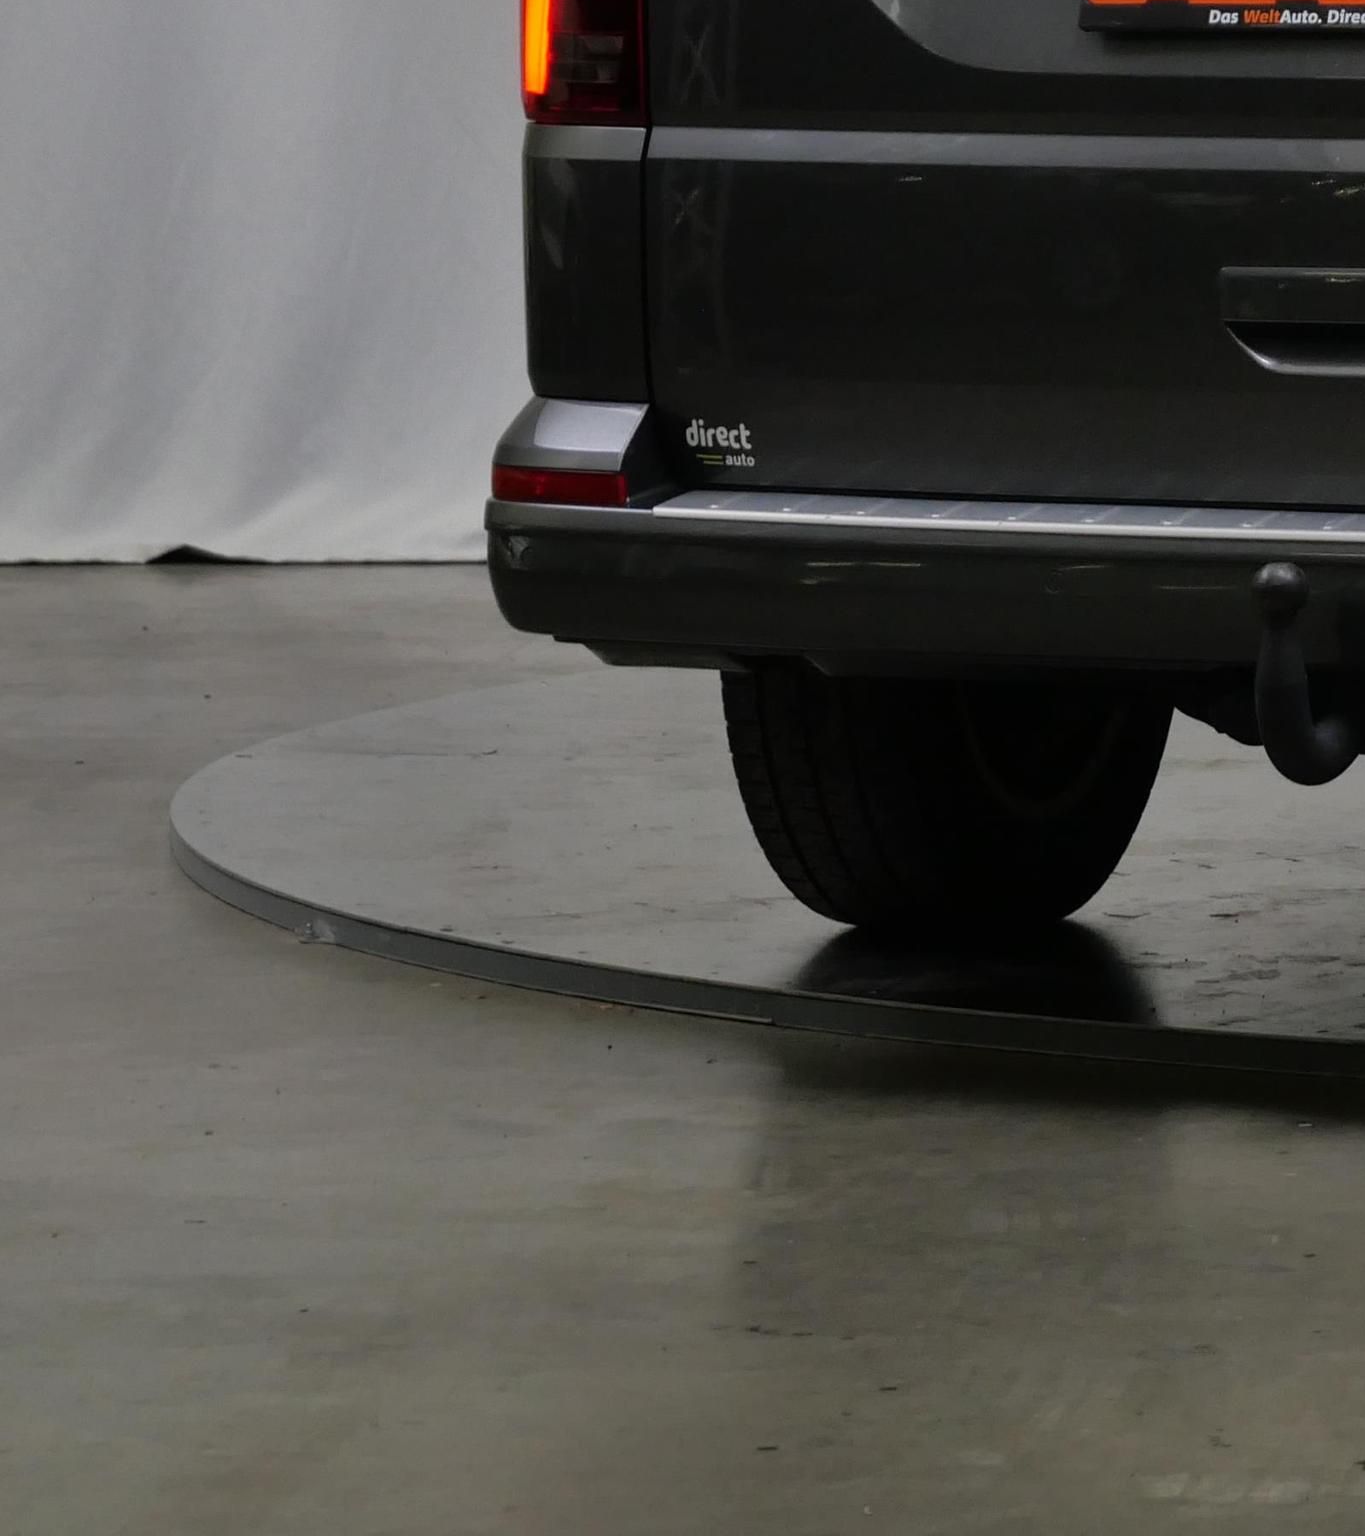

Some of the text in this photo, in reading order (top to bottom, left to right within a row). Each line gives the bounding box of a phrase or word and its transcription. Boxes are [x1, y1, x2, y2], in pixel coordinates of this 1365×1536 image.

[1208, 9, 1239, 24] Das
[1243, 8, 1322, 25] WeltAuto.
[685, 418, 752, 450] direct
[725, 453, 756, 467] auto
